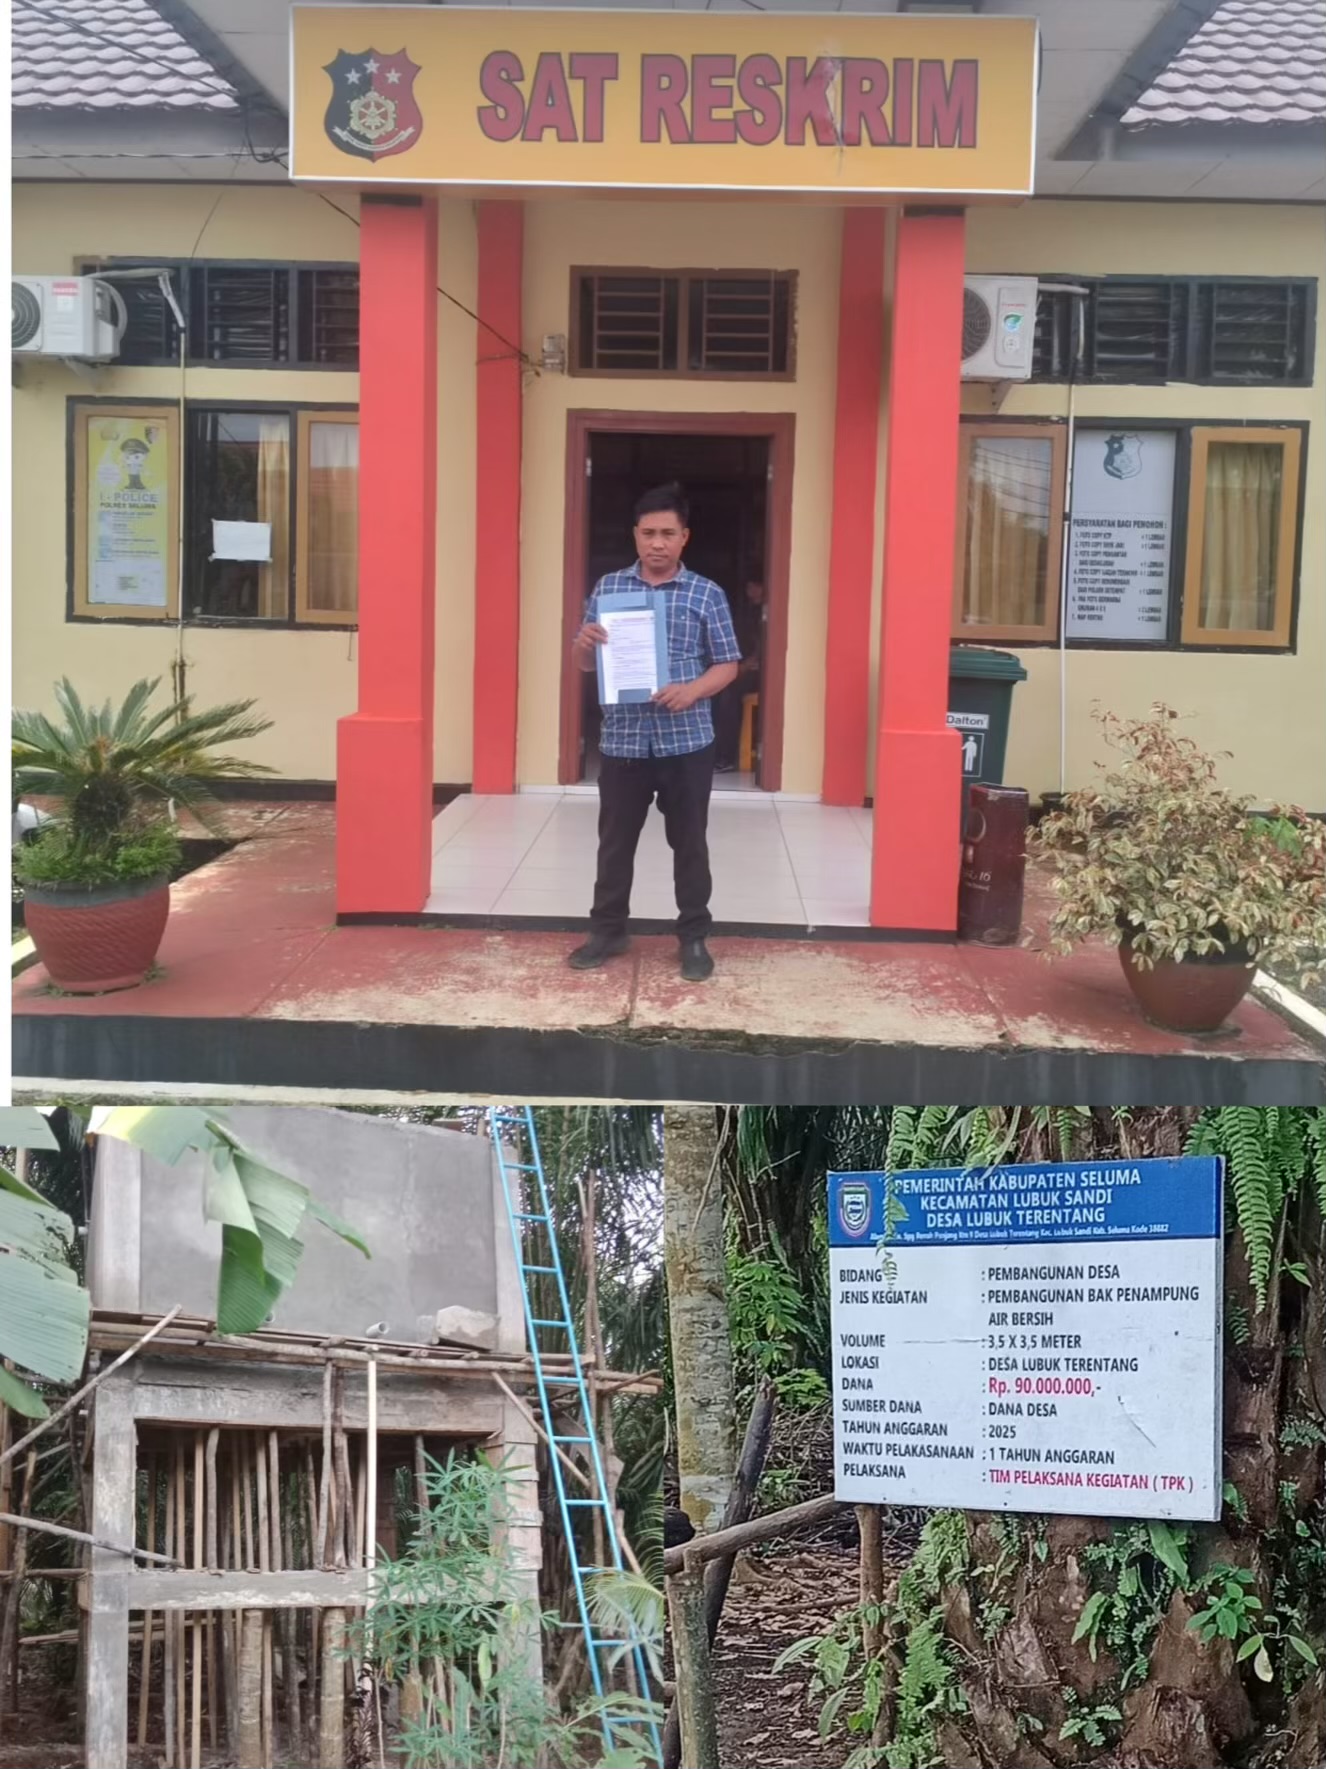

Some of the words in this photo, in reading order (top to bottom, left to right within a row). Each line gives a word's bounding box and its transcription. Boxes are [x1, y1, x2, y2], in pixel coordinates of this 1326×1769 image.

[477, 50, 619, 143] SAT
[640, 53, 979, 148] RESKRIM
[114, 492, 160, 503] POLICE
[1072, 518, 1115, 528] PERSYARATAN
[947, 715, 984, 726] Dalton
[894, 1175, 984, 1194] PEMERINTAH
[989, 1171, 1076, 1191] KABUPATEN
[1080, 1168, 1141, 1187] SELUMA
[920, 1193, 1008, 1211] KECAMATAN
[1013, 1191, 1061, 1208] LUBUK
[1065, 1188, 1112, 1205] SANDI
[926, 1212, 963, 1228] DESA
[966, 1210, 1013, 1227] LUBUK
[1016, 1207, 1106, 1226] TERENTANG
[839, 1269, 883, 1283] BIDANG
[988, 1266, 1084, 1281] PEMBANGUNAN
[1088, 1265, 1120, 1279] DESA
[839, 1290, 869, 1304] JENIS
[872, 1290, 928, 1304] KEGIATAN
[988, 1289, 1084, 1303] PEMBANGUNAN
[1088, 1288, 1113, 1302] BAK
[1117, 1286, 1200, 1302] PENAMPUNG
[988, 1312, 1008, 1326] AIR
[1011, 1312, 1054, 1326] BERSIH
[840, 1333, 886, 1348] VOLUME
[988, 1335, 1005, 1350] 3,5
[1008, 1335, 1017, 1348] X
[1020, 1335, 1037, 1350] 3,5
[1041, 1334, 1082, 1349] METER
[841, 1356, 879, 1369] LOKASI
[989, 1357, 1018, 1371] DESA
[1022, 1357, 1061, 1371] LUBUK
[1064, 1357, 1139, 1372] TERENTANG
[842, 1377, 873, 1391] DANA
[989, 1377, 1010, 1397] Rp.
[1015, 1377, 1101, 1397] 90.000.000,-
[842, 1398, 886, 1413] SUMBER
[889, 1400, 922, 1414] DANA
[989, 1402, 1023, 1416] DANA
[1027, 1403, 1057, 1417] DESA
[842, 1420, 881, 1434] TAHUN
[883, 1422, 948, 1436] ANGGARAN
[989, 1425, 1016, 1438] 2025
[842, 1442, 883, 1456] WAKTU
[885, 1443, 974, 1459] PELAKASANAAN
[989, 1447, 995, 1460] 1
[999, 1447, 1041, 1462] TAHUN
[1044, 1450, 1115, 1465] ANGGARAN
[843, 1463, 906, 1478] PELAKSANA
[989, 1469, 1010, 1483] TIM
[1014, 1470, 1083, 1487] PELAKSANA
[1086, 1473, 1149, 1489] KEGIATAN
